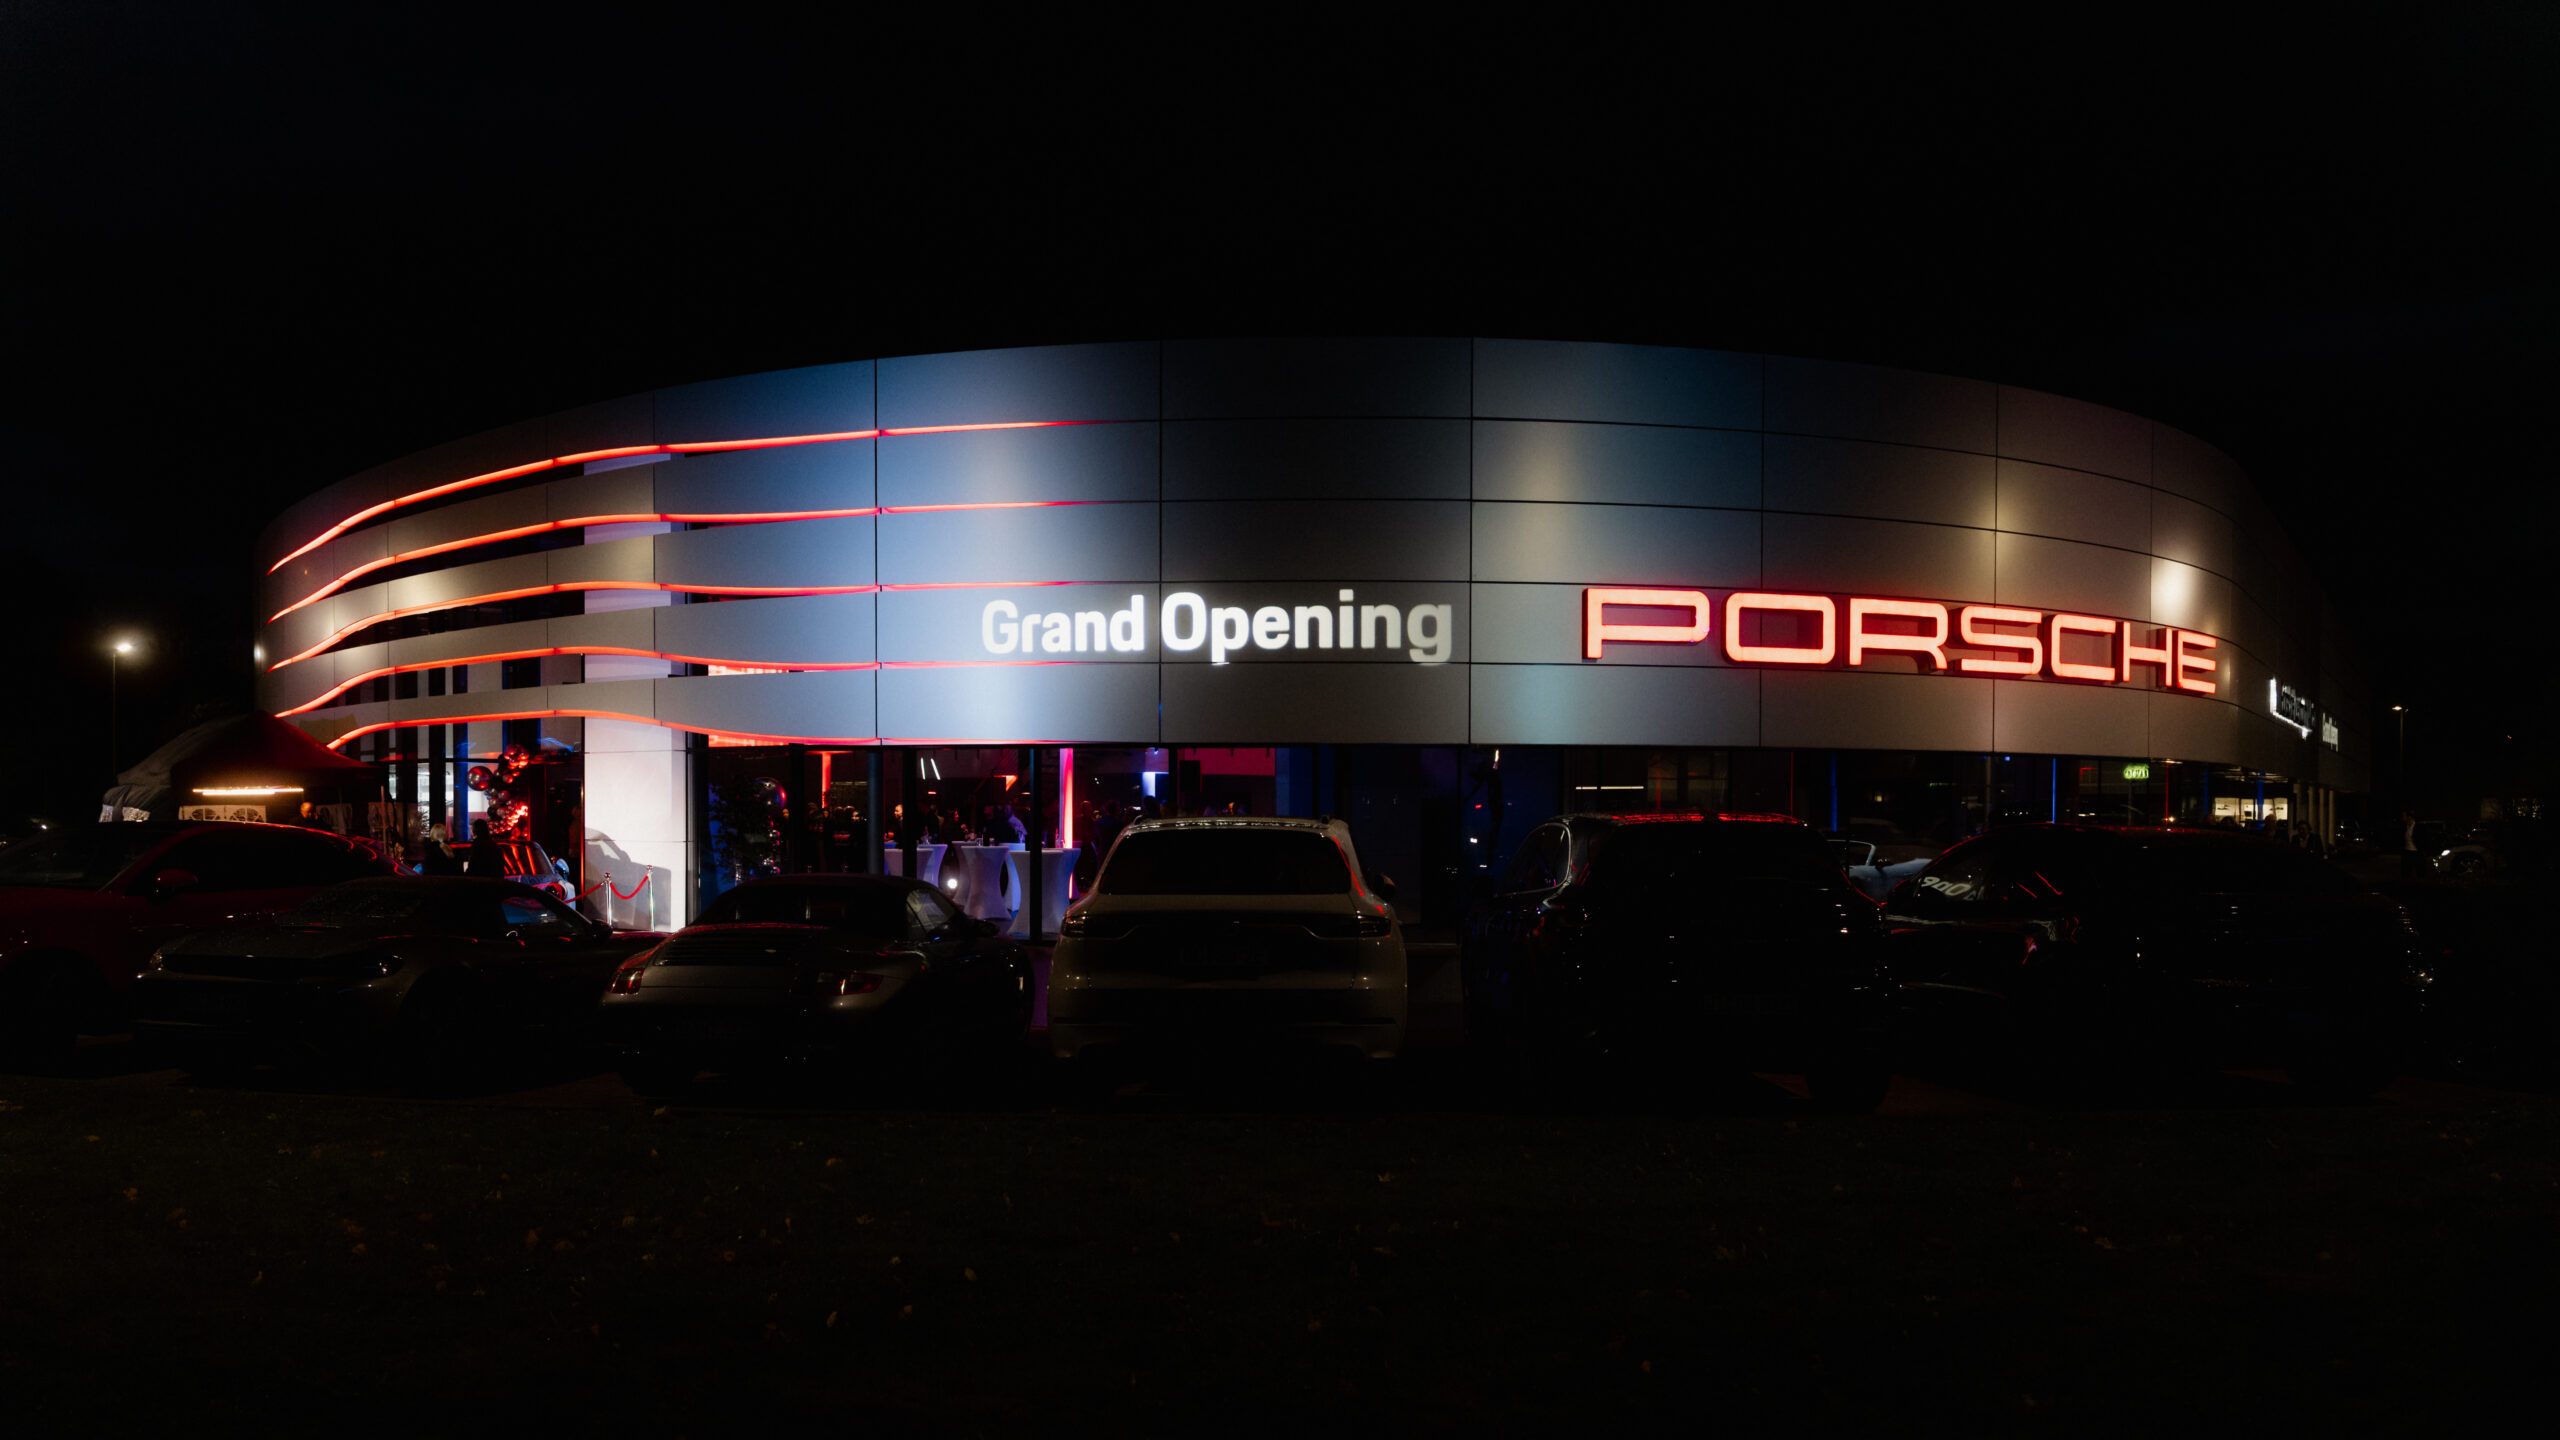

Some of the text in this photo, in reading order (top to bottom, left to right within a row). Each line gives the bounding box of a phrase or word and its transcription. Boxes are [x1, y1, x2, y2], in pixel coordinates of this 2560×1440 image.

[981, 589, 1452, 666] Grand Opening
[1583, 587, 2216, 694] PORSCHE
